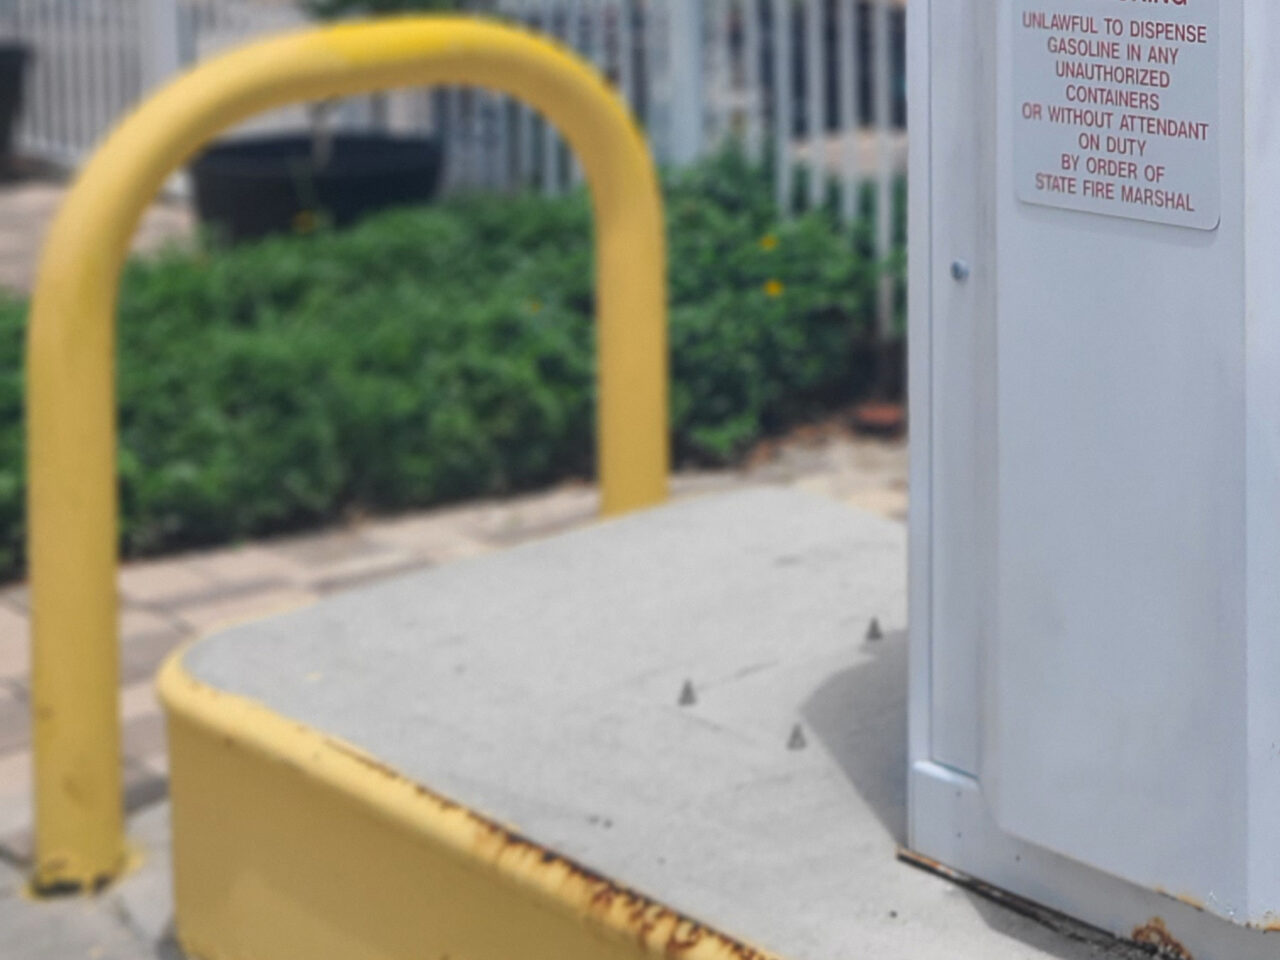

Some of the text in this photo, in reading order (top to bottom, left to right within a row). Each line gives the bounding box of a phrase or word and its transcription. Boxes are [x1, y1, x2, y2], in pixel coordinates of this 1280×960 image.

[1022, 10, 1207, 43] UNLAWFUL TO DISPENSE
[1047, 36, 1179, 65] GASOLINE IN ANY
[1055, 60, 1170, 88] UNAUTHORIZED
[1066, 84, 1160, 111] CONTAINERS
[1022, 102, 1209, 141] OR WITHOUT ATTENDANT
[1078, 133, 1146, 157] ON DUTY
[1061, 153, 1165, 183] BY ORDER OF
[1035, 172, 1195, 212] STATE FIRE MARSHAL
